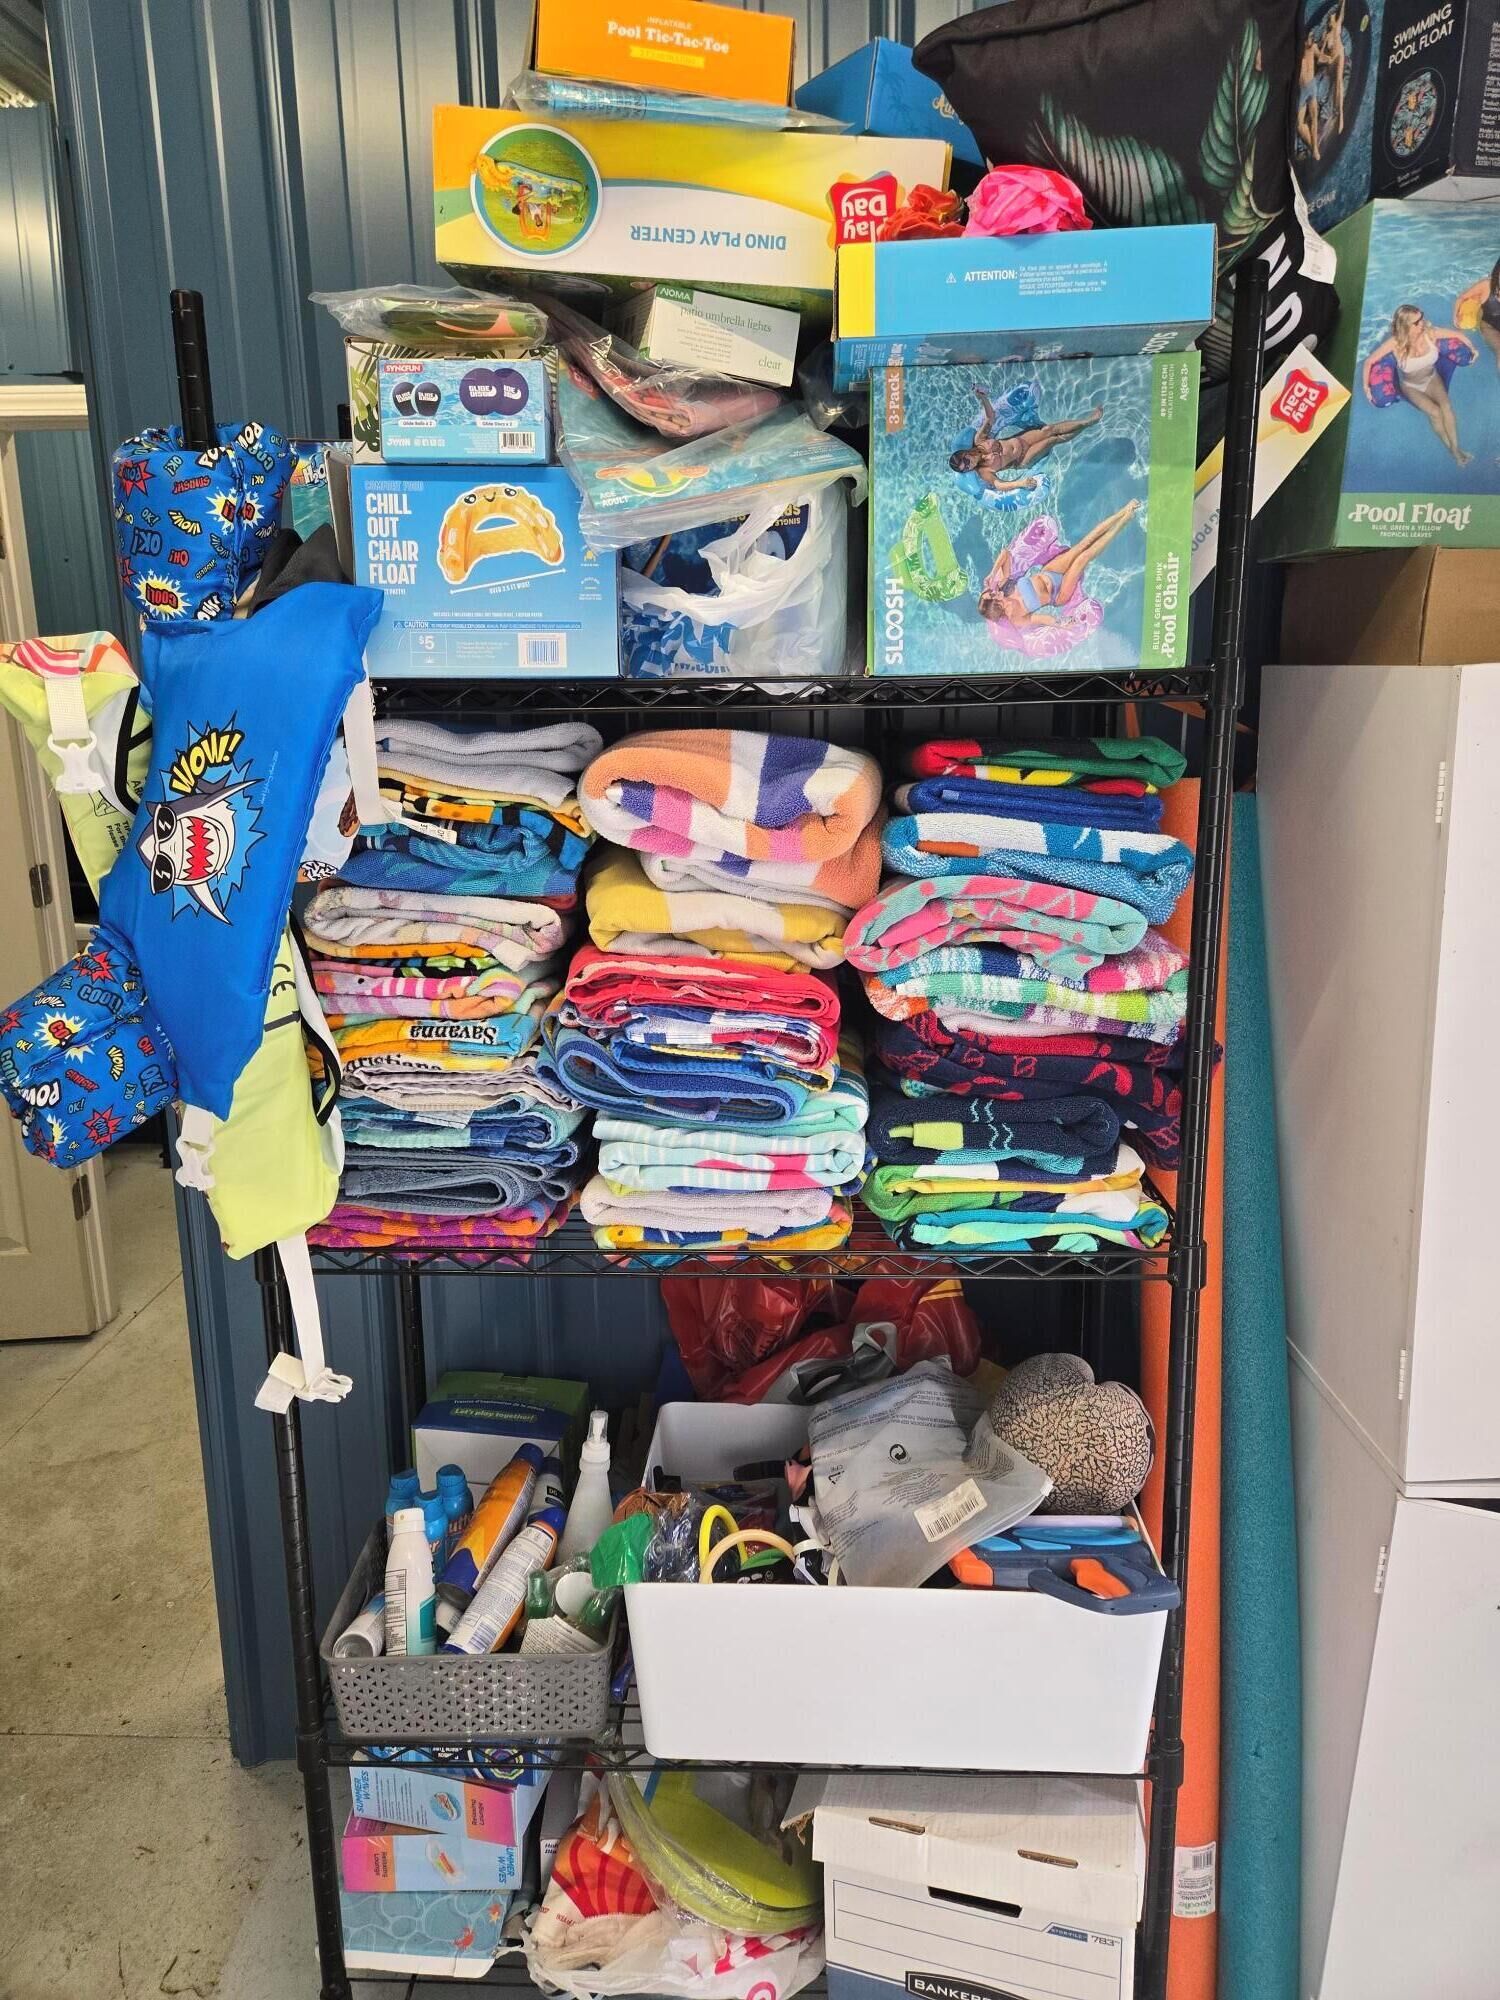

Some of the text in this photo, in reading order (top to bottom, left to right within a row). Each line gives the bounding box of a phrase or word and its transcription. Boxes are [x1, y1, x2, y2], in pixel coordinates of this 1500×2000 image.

[607, 20, 730, 54] Pool Tic-Tac-Toe
[1392, 3, 1453, 50] SWIMMING
[1387, 18, 1456, 69] POOL FLOAT
[841, 187, 888, 218] Day
[630, 225, 787, 251] DINO PLAY CENTER
[964, 269, 1018, 282] ATTENTION:
[659, 287, 691, 301] NOMA
[681, 305, 773, 334] patio umbrella lights
[385, 365, 421, 373] SYNCFUN
[758, 356, 782, 370] clear
[888, 372, 900, 425] 3-Pack
[1180, 376, 1190, 401] Ages
[1279, 380, 1307, 418] Day
[1292, 386, 1320, 424] Play
[165, 455, 182, 476] OK!
[365, 493, 412, 516] CHILL
[602, 495, 629, 508] ADULT
[367, 516, 399, 538] OUT
[1347, 502, 1473, 531] Pool Float
[132, 529, 162, 555] OK!
[368, 540, 419, 562] CHAIR
[169, 550, 189, 566] OH!
[369, 563, 417, 585] FLOAT
[1154, 592, 1162, 620] GREEN
[1161, 551, 1180, 659] Pool Chair
[885, 576, 904, 666] SLOOSH
[419, 635, 435, 651] $5
[1152, 630, 1161, 650] BLUE
[170, 731, 244, 795] WOW!
[79, 985, 122, 1013] COOL!
[410, 1024, 497, 1046] Savanna
[140, 1065, 168, 1096] OK!
[67, 1097, 86, 1114] OK!
[475, 1410, 495, 1418] play
[354, 1777, 364, 1814] SUMMER
[359, 1769, 370, 1801] WAVES
[498, 1855, 507, 1885] WAVES
[506, 1846, 516, 1878] UMMER
[1091, 1935, 1115, 1947] 783
[913, 1979, 991, 2000] BANKER
